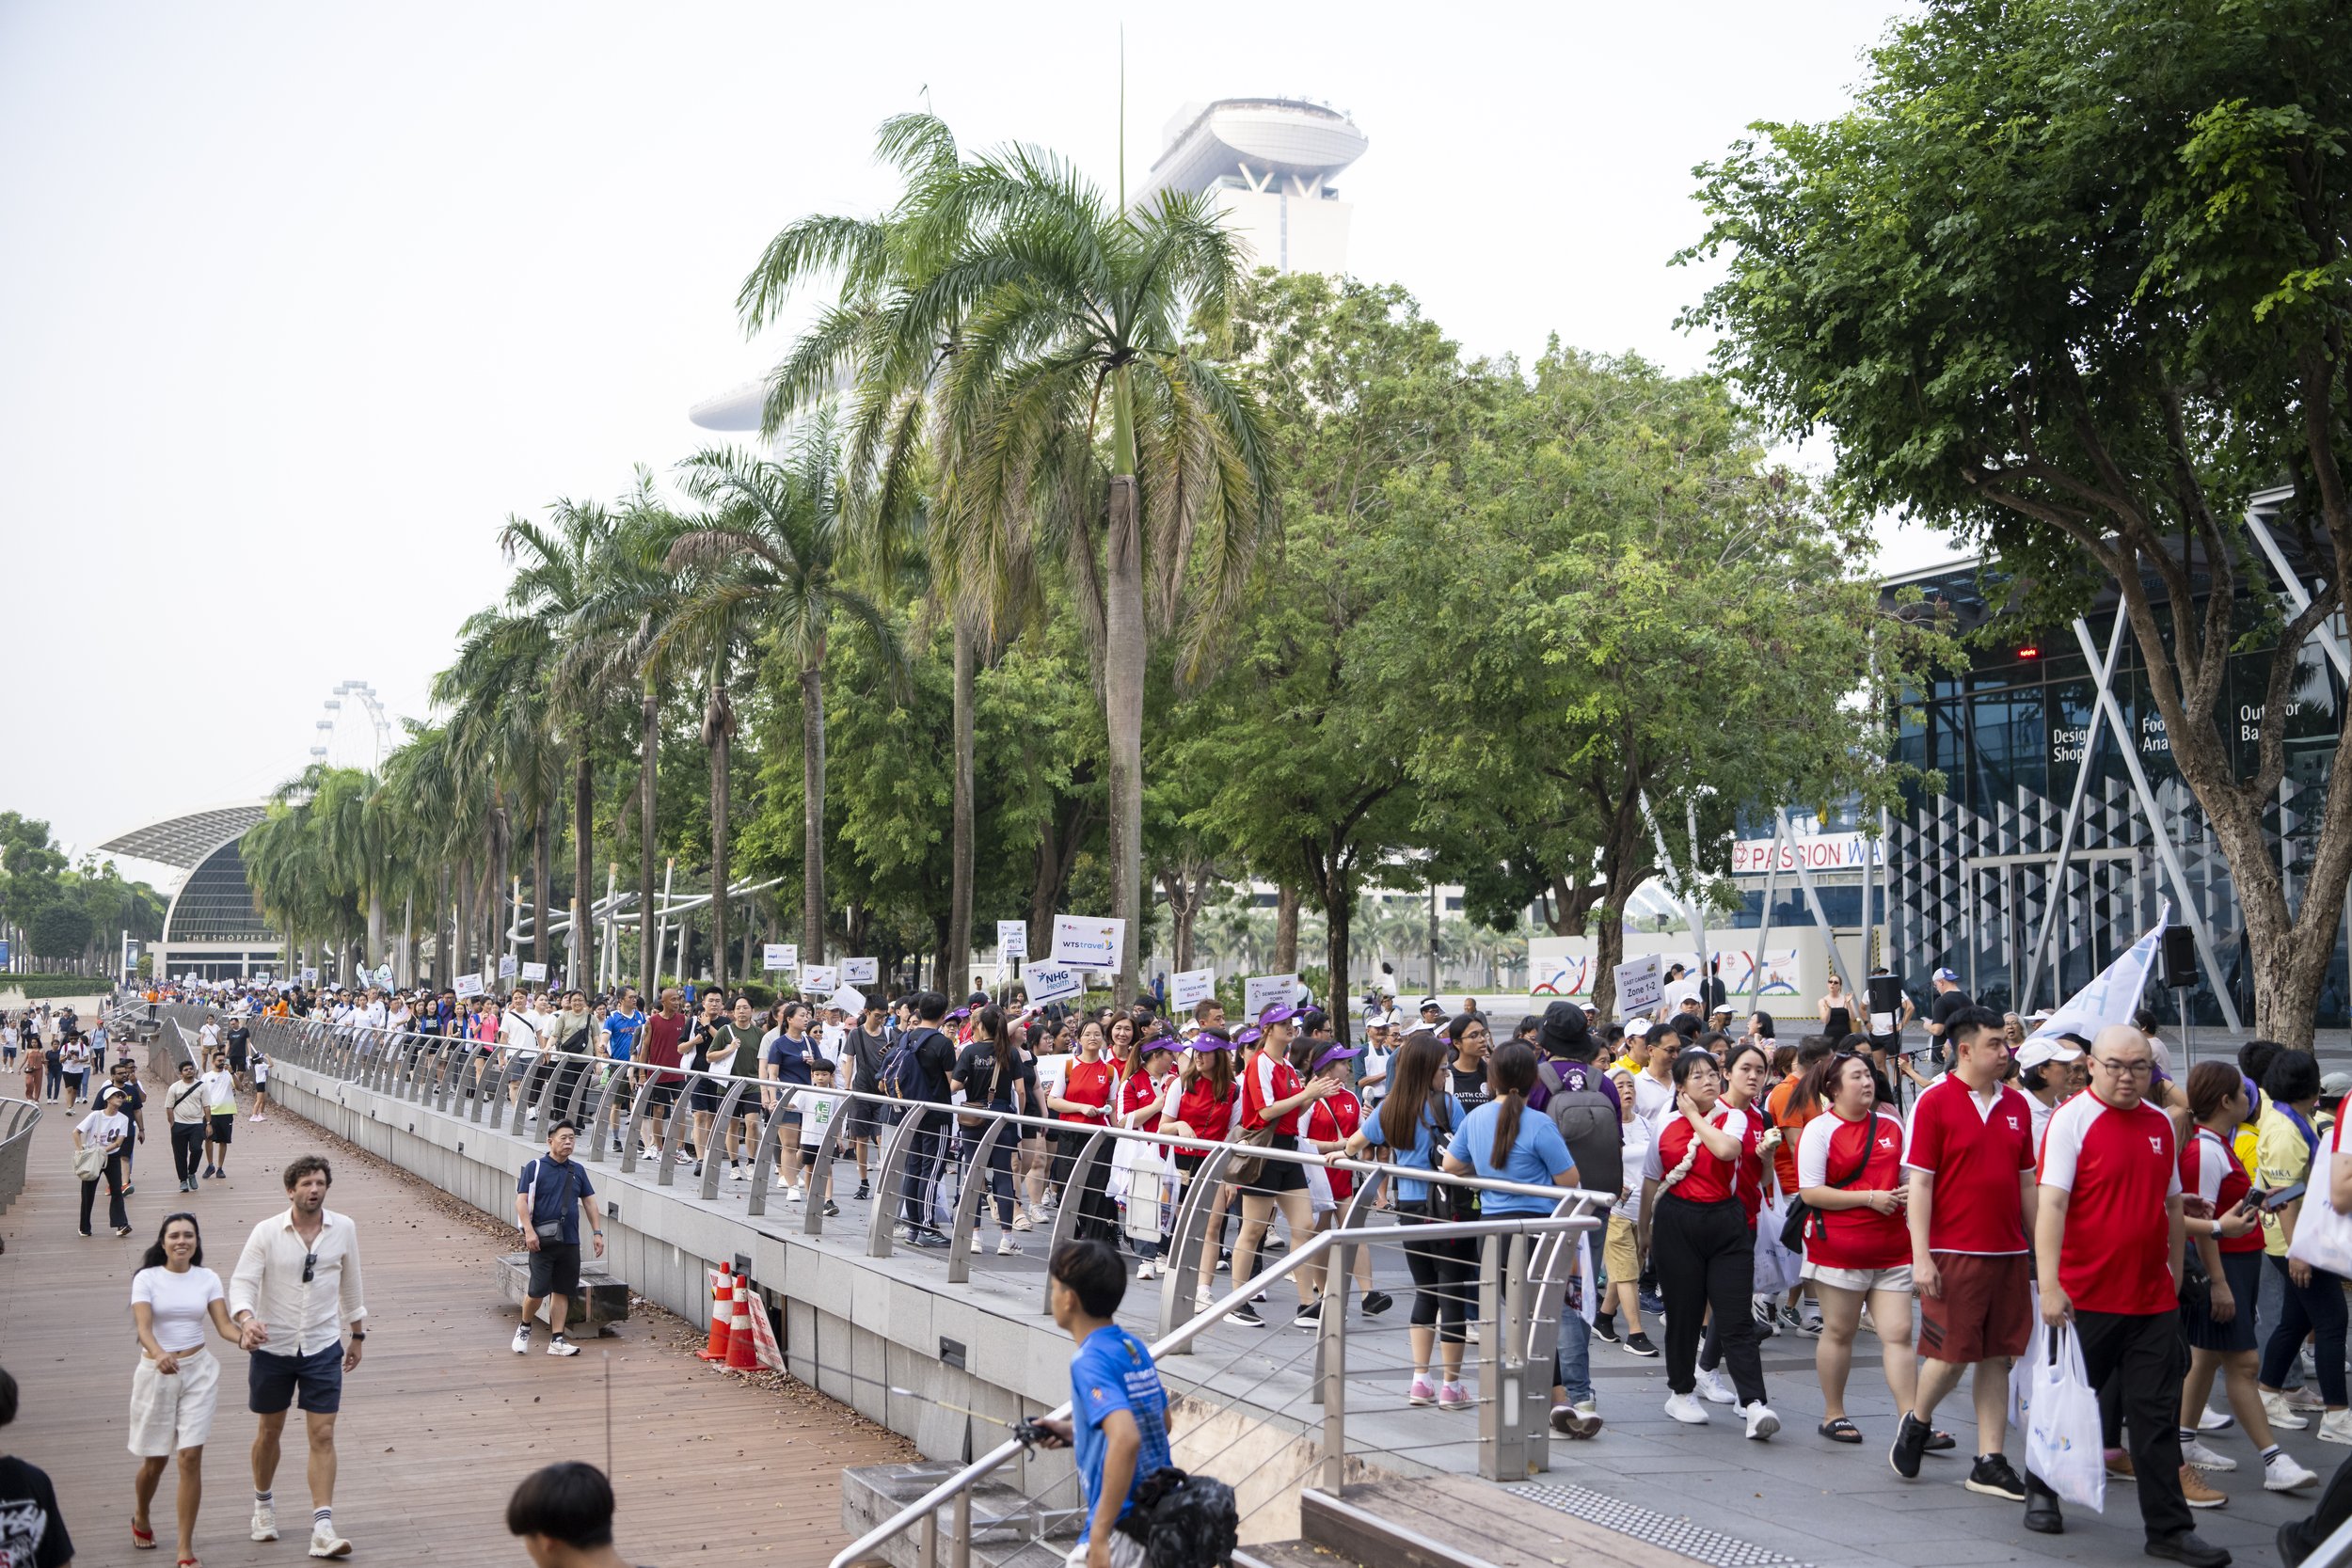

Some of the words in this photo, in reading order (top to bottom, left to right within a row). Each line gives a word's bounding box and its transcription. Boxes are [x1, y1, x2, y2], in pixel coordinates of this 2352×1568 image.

[2240, 703, 2301, 721] Outor
[2142, 718, 2165, 734] Foo
[2241, 725, 2259, 741] Ba
[2053, 727, 2090, 745] Desig
[2142, 736, 2169, 752] Ana
[1849, 840, 1881, 863] WA
[1045, 971, 1069, 984] NHG
[1046, 979, 1070, 990] Health
[1634, 972, 1657, 983] CANBERRA
[1627, 987, 1645, 997] Zone
[1645, 981, 1656, 991] 1-2
